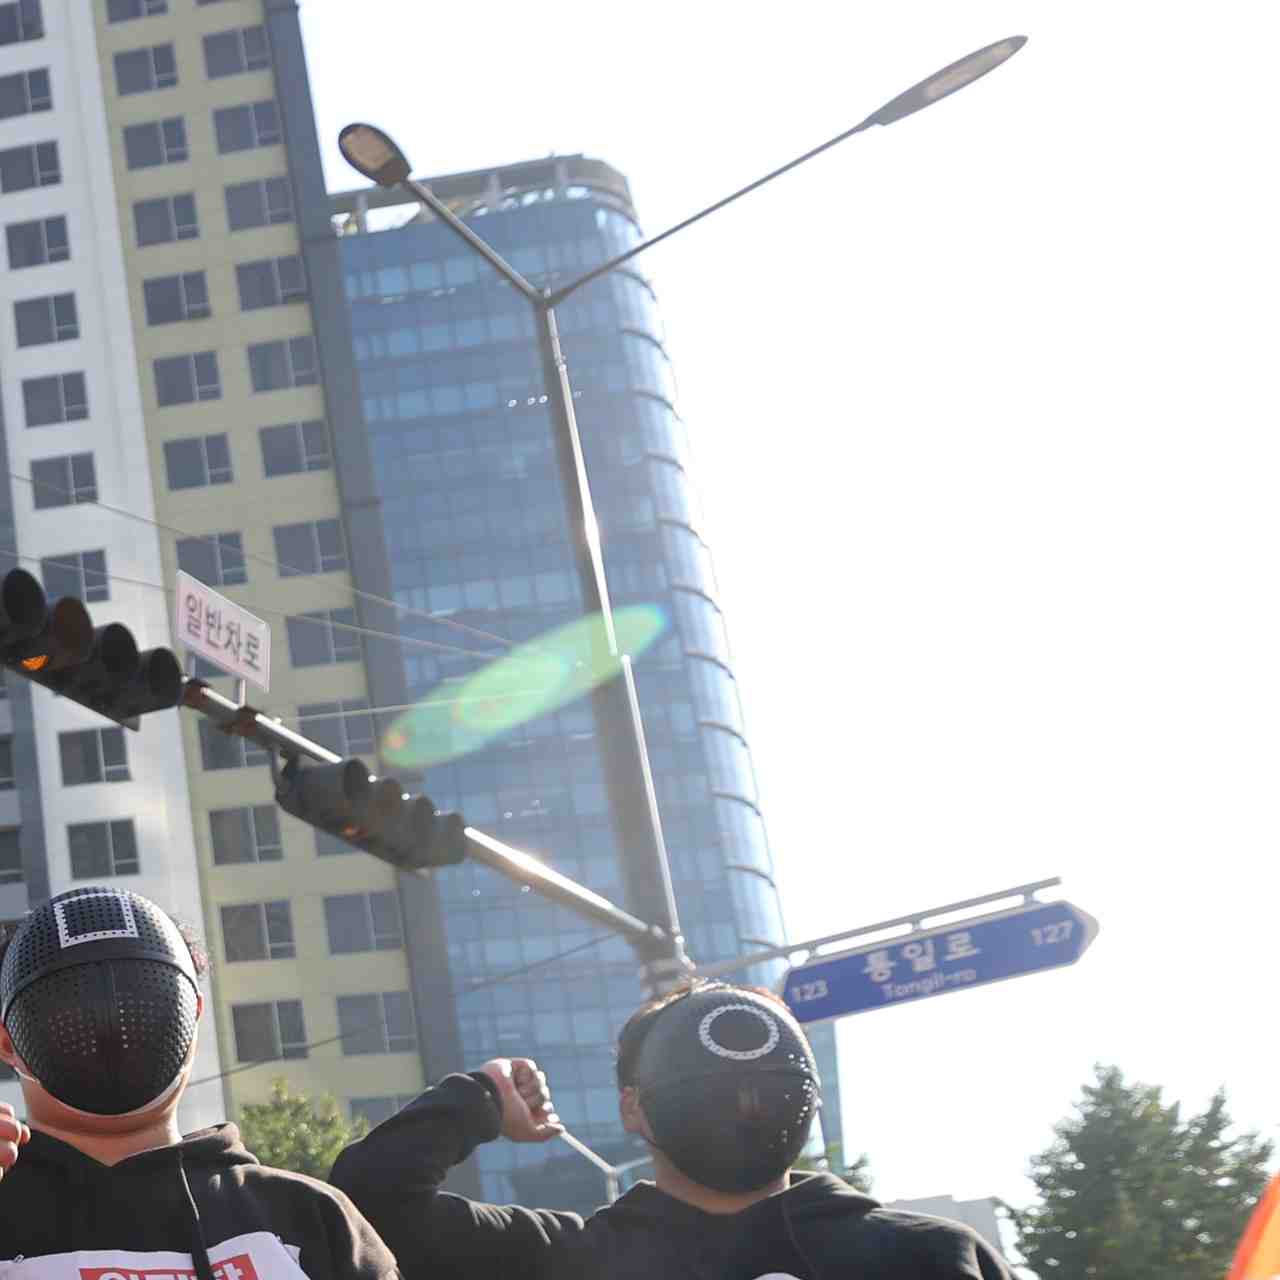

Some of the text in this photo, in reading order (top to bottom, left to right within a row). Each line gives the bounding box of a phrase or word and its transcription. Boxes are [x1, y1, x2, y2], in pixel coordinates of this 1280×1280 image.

[184, 592, 263, 672] 일반차로
[1031, 920, 1074, 946] 127
[862, 932, 981, 983] 통일로
[791, 980, 830, 1002] 123
[882, 966, 978, 1000] Tongil-ro
